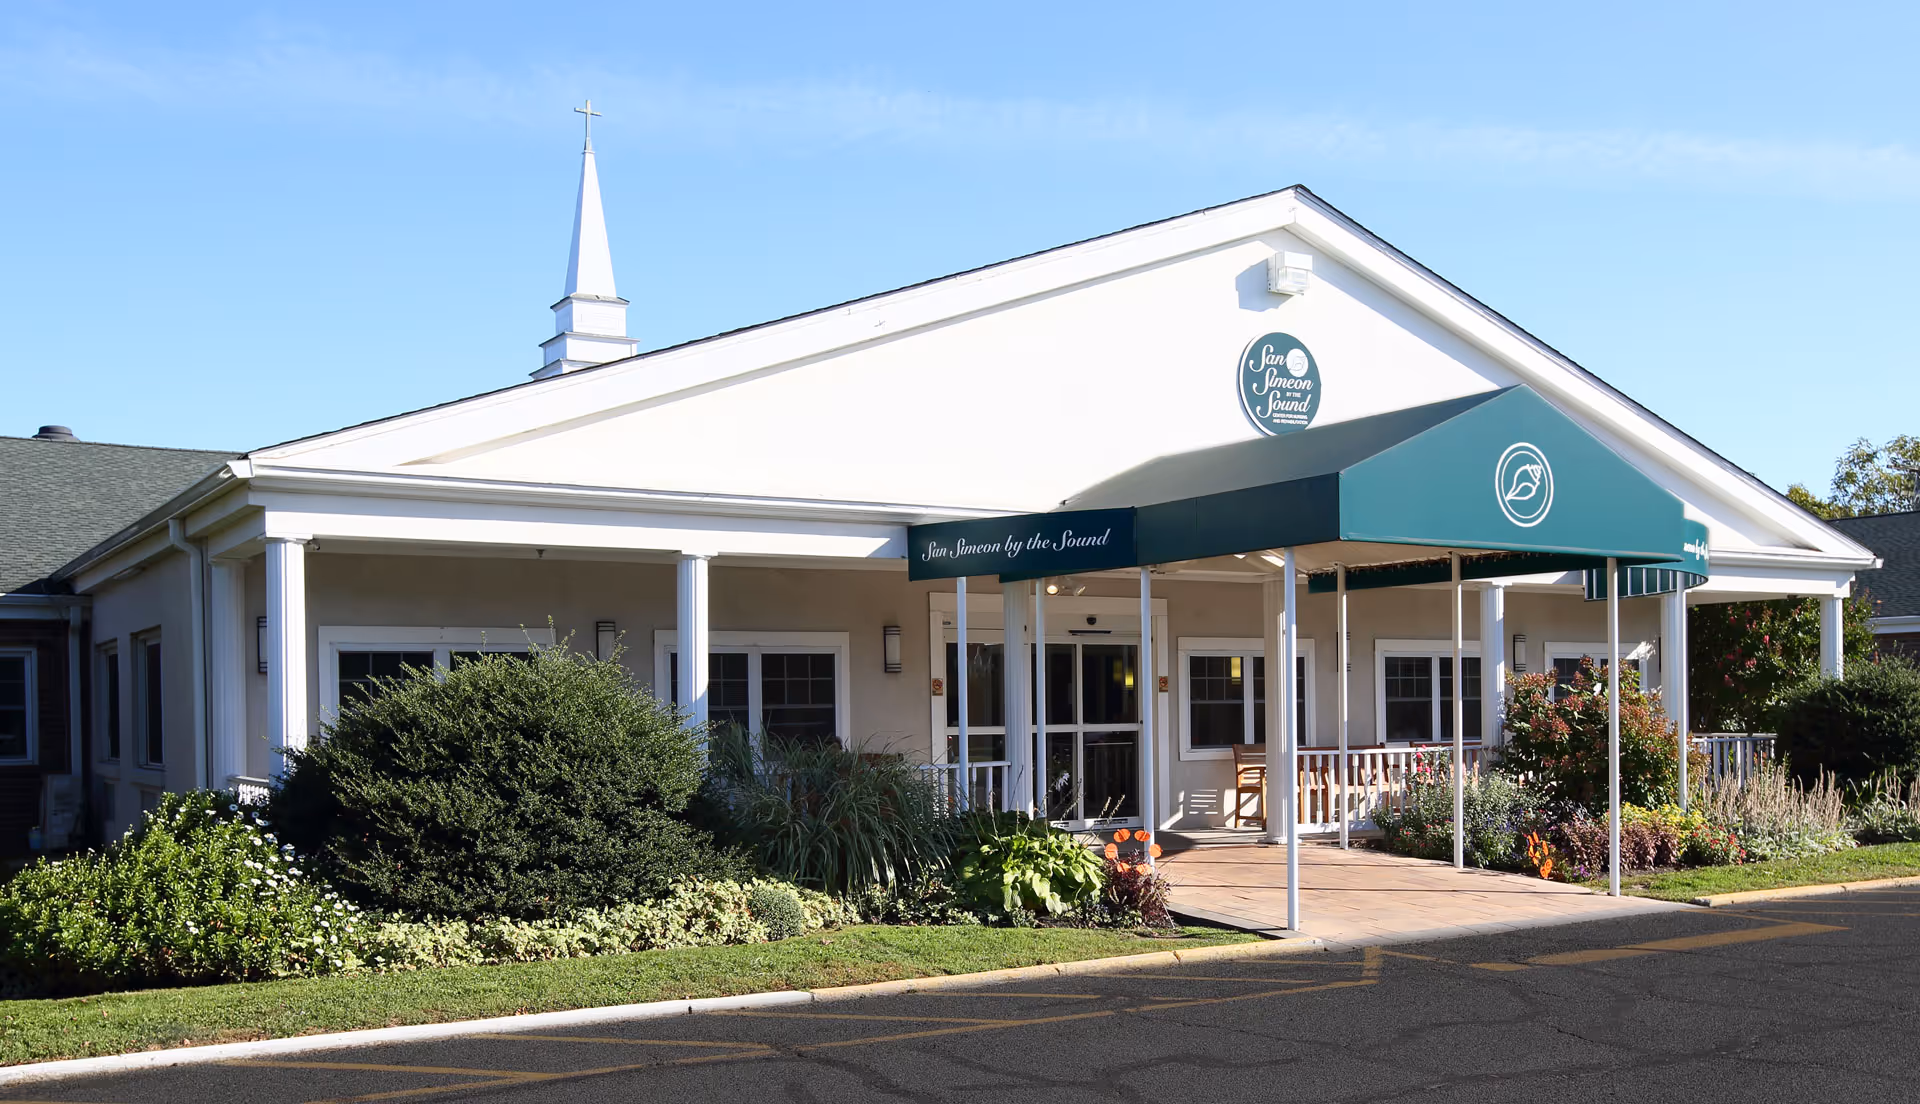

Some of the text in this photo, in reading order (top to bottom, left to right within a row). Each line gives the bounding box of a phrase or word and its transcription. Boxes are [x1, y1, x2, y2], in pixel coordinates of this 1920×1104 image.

[1249, 344, 1287, 372] San
[1252, 367, 1313, 395] Simeon
[1256, 390, 1311, 418] Sound
[922, 528, 1111, 561] San Simeon by the Sound
